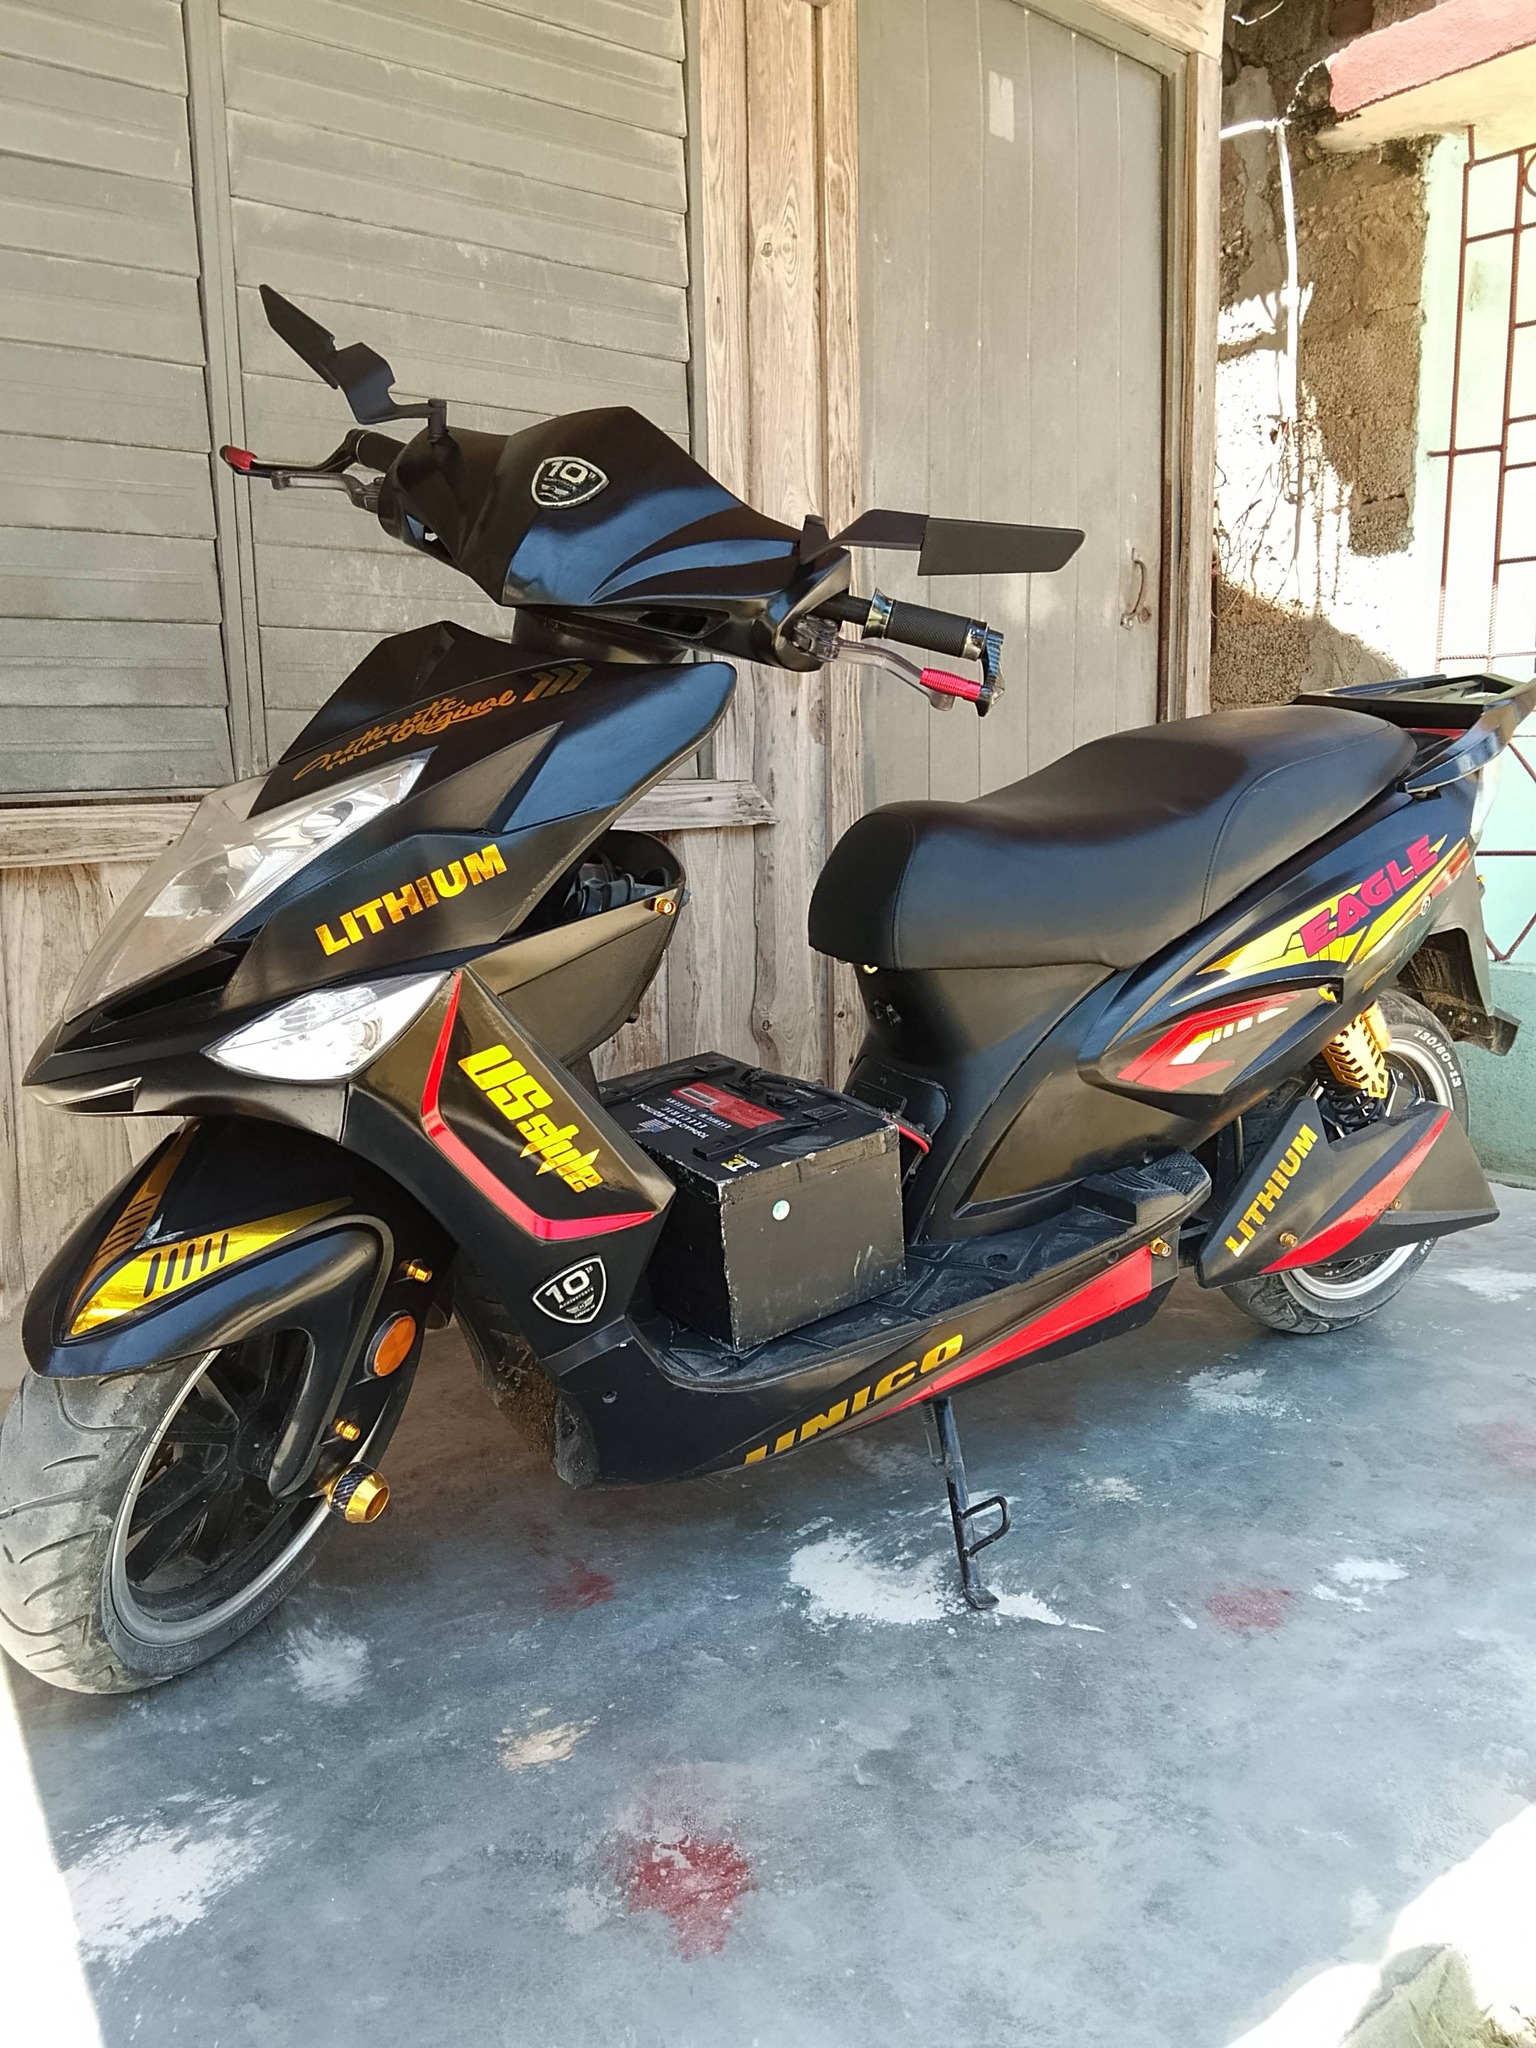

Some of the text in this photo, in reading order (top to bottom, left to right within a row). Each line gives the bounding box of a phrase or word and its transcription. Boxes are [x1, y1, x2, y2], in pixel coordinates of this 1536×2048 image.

[391, 689, 517, 743] Original
[315, 843, 508, 956] LITHIUM
[1300, 834, 1438, 958] EAGLE
[660, 1106, 708, 1129] ELECTRIC
[1224, 1123, 1319, 1258] LITHIUM
